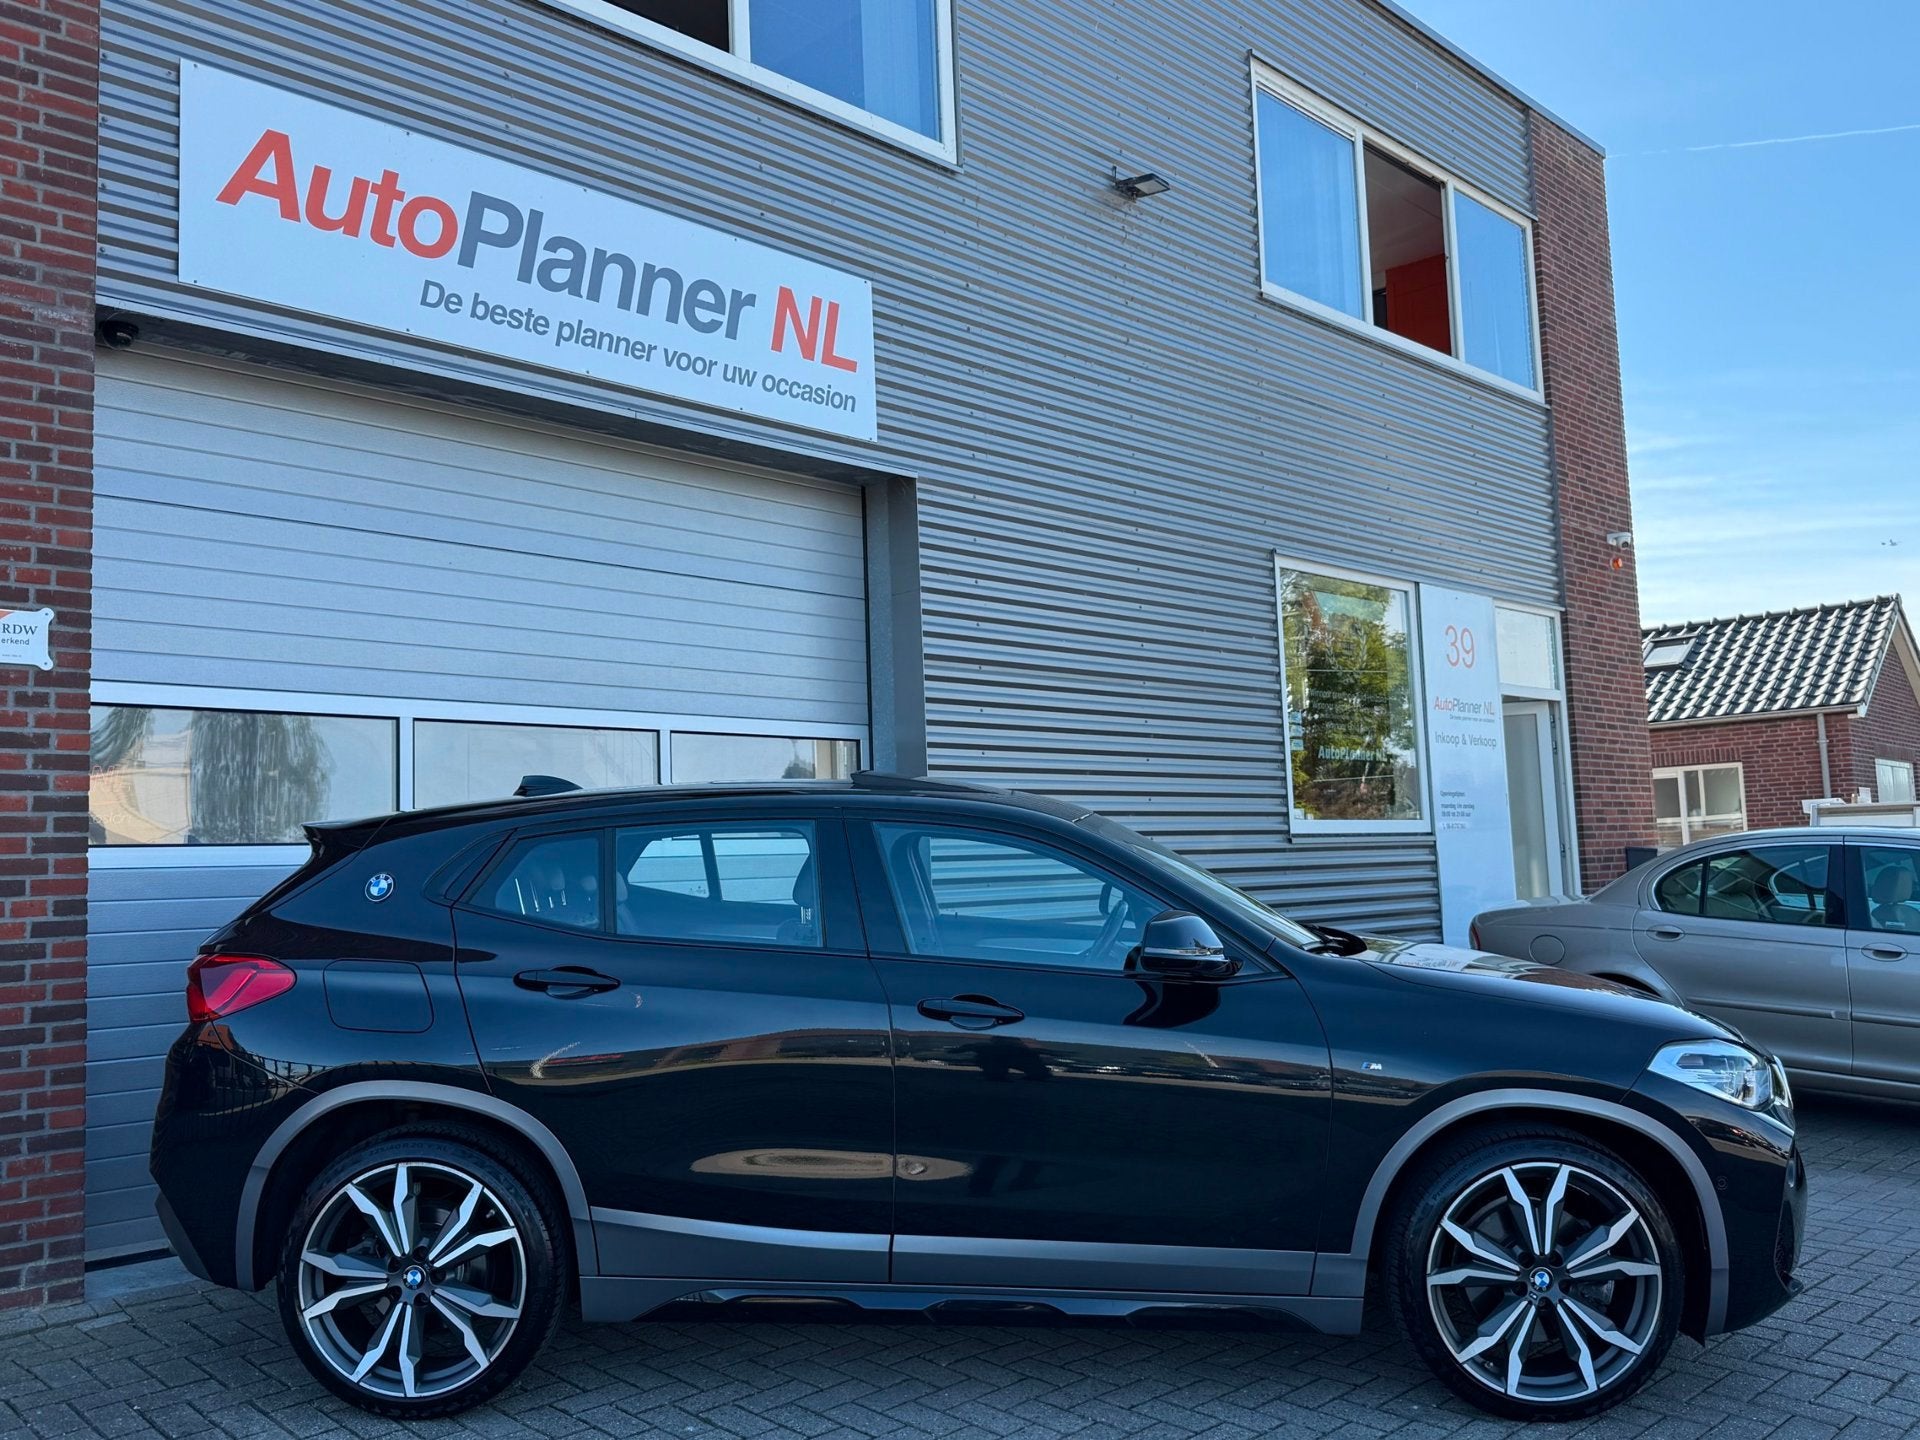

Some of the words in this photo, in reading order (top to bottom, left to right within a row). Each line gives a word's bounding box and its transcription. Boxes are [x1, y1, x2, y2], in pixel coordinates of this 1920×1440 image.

[215, 128, 757, 341] AutoPlanner
[770, 285, 858, 373] NL
[419, 279, 463, 315] De
[469, 292, 550, 336] beste
[554, 319, 658, 363] planner
[663, 347, 719, 378] voor
[722, 363, 758, 388] uw
[761, 374, 857, 413] occasion
[2, 623, 38, 636] RDW
[1, 637, 30, 646] erkend
[1445, 624, 1475, 669] 39
[1434, 696, 1482, 714] AutoPlanner
[1483, 701, 1495, 716] NL
[1435, 731, 1460, 748] Inkoop
[1461, 734, 1468, 745] &
[1468, 734, 1497, 750] Verkoop
